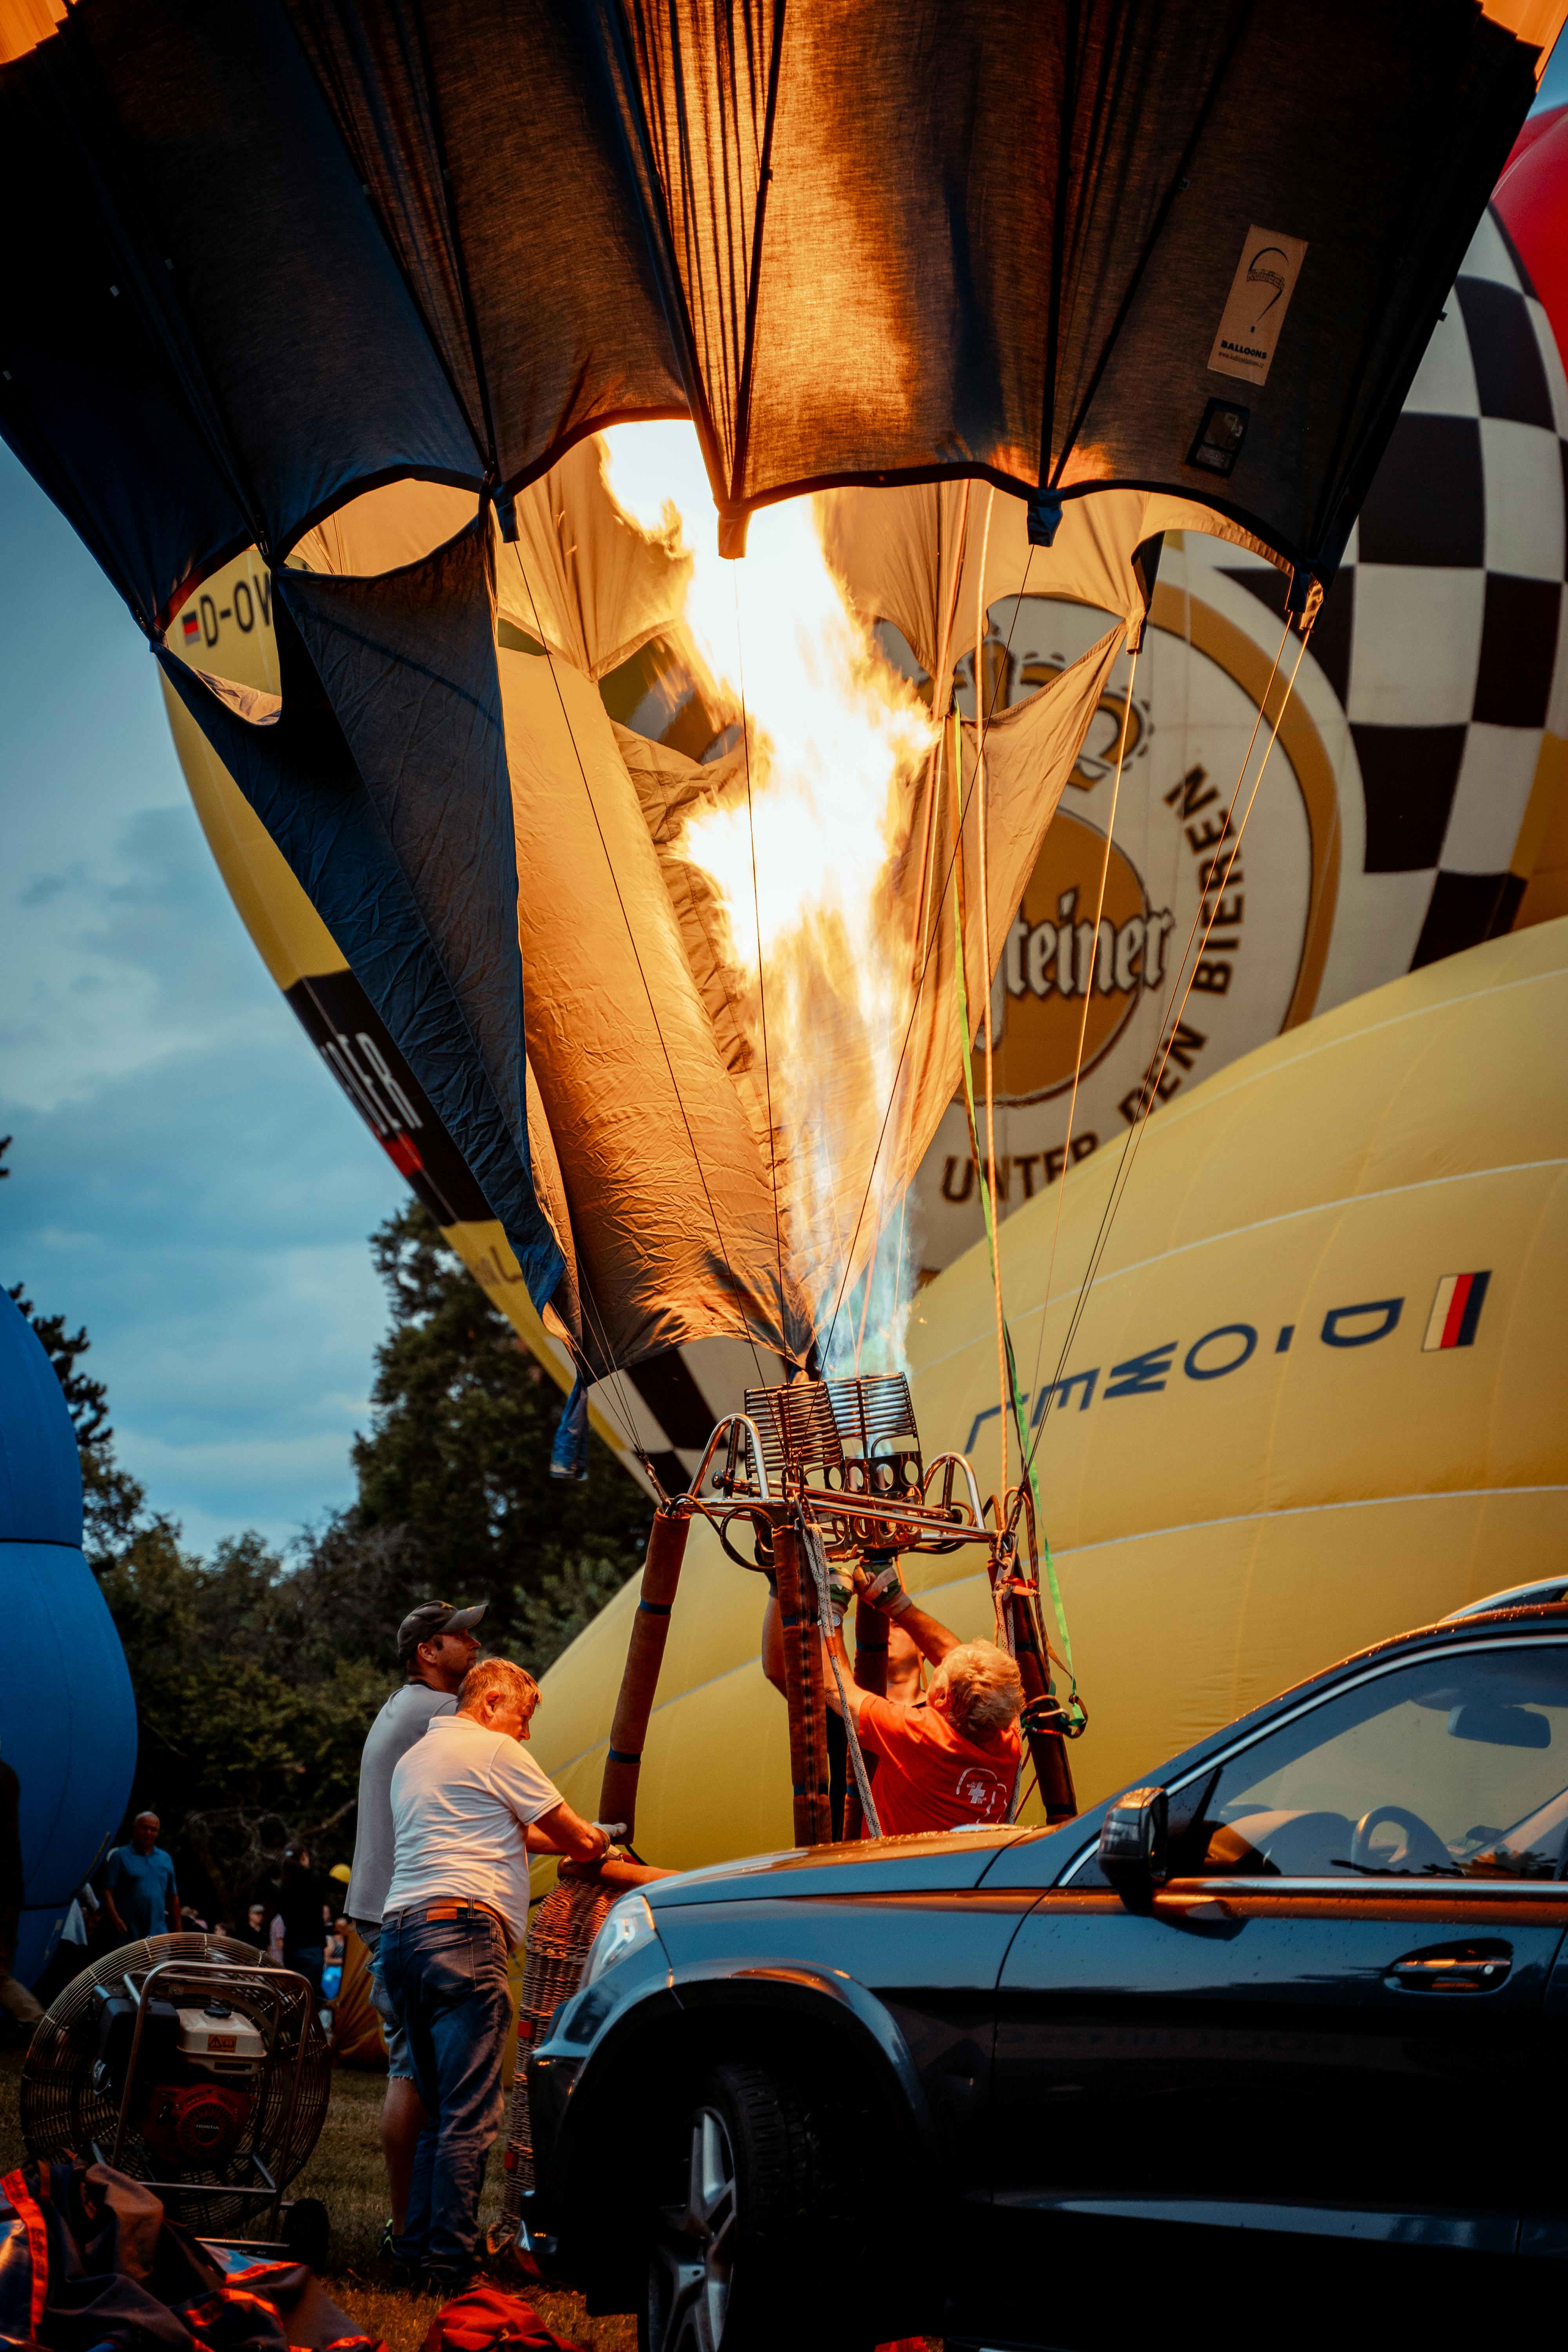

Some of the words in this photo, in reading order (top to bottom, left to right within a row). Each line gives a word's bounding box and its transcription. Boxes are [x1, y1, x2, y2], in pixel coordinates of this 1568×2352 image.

[1221, 340, 1267, 359] BALLOONS
[1118, 1019, 1207, 1125] DEN
[1164, 764, 1244, 996] BIEREN
